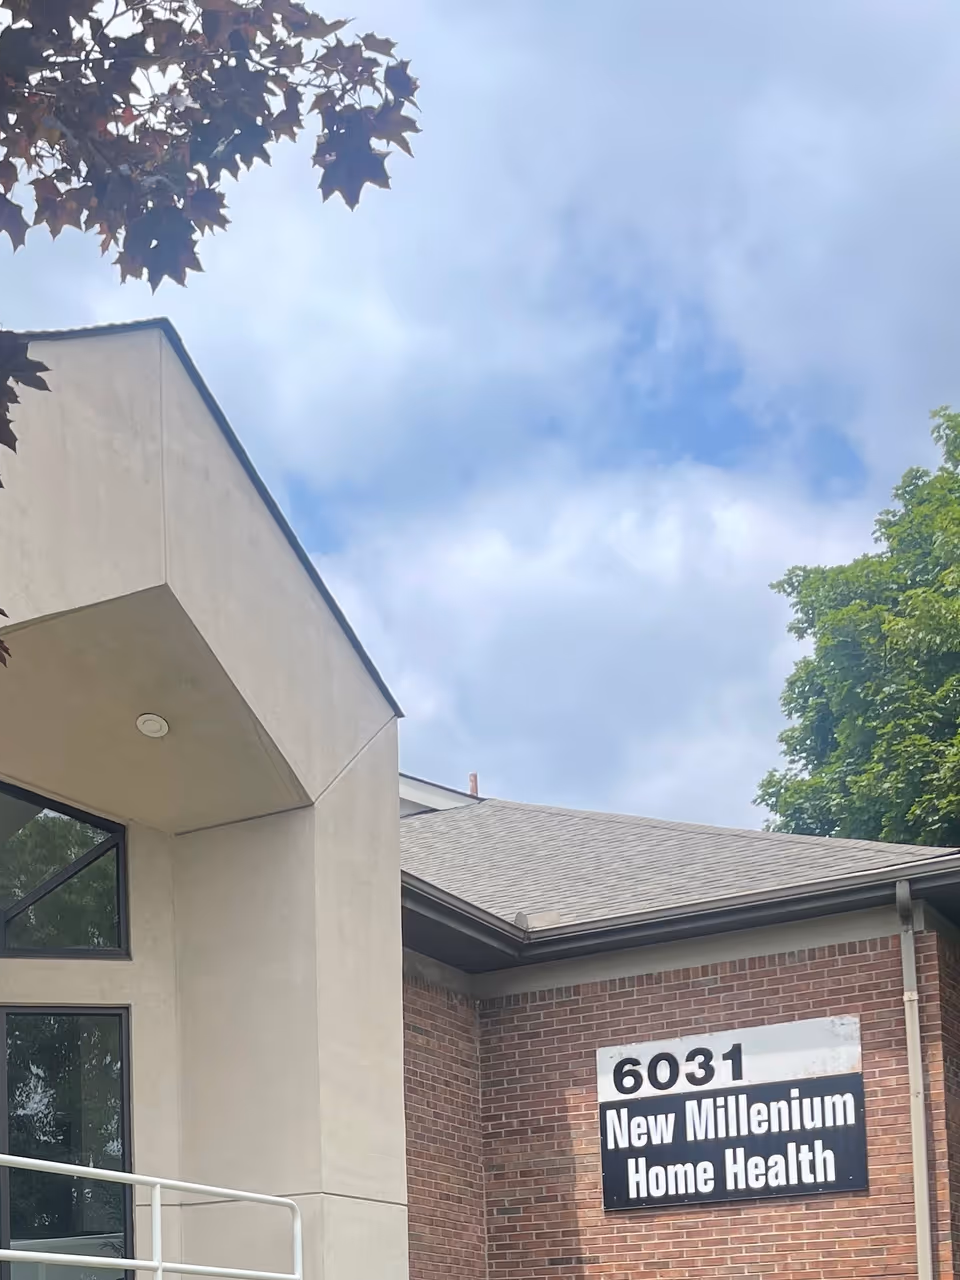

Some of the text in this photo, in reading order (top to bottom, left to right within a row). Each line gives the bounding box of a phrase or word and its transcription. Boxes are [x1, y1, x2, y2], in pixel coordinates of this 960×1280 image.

[613, 1043, 744, 1095] 6031
[605, 1088, 856, 1150] New Millenium
[626, 1140, 836, 1199] Home Health
